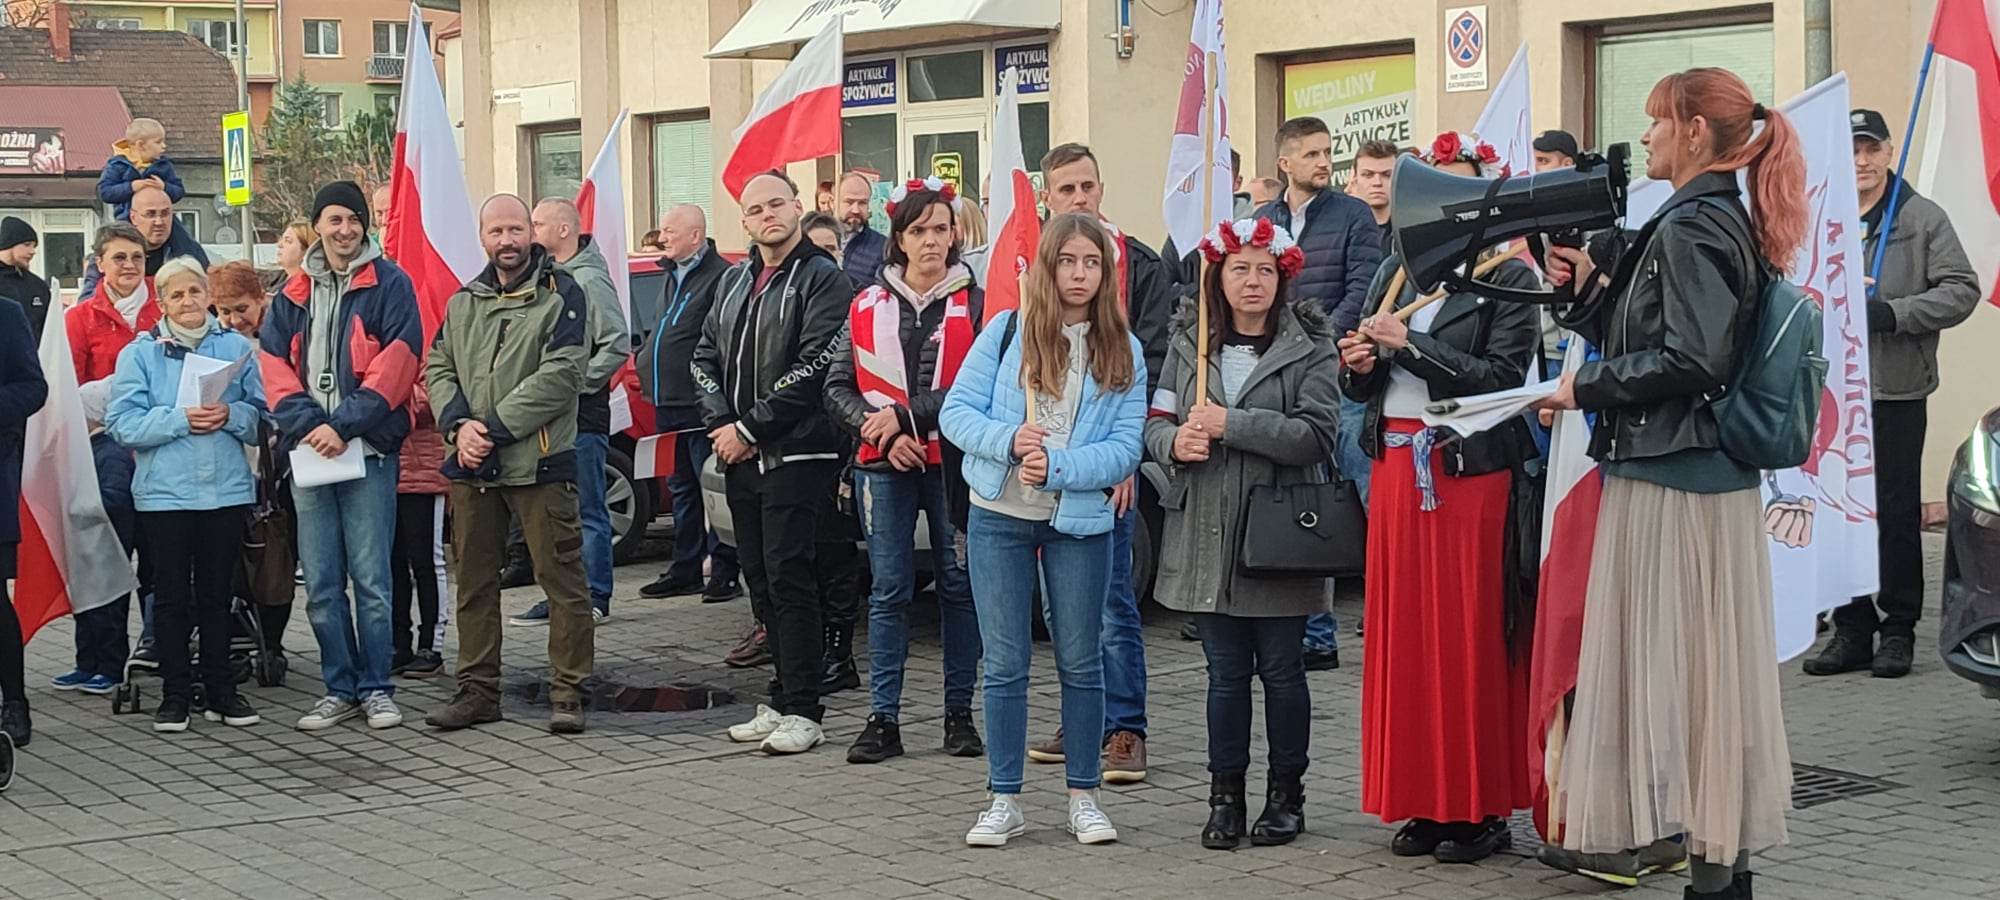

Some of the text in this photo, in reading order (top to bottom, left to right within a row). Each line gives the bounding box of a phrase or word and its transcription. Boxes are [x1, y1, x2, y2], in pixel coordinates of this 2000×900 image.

[842, 82, 895, 101] SPOŻYWCZE
[1293, 70, 1376, 109] WĘDLINY
[1343, 99, 1409, 127] ARTYKUŁY
[0, 131, 36, 149] OŻNA
